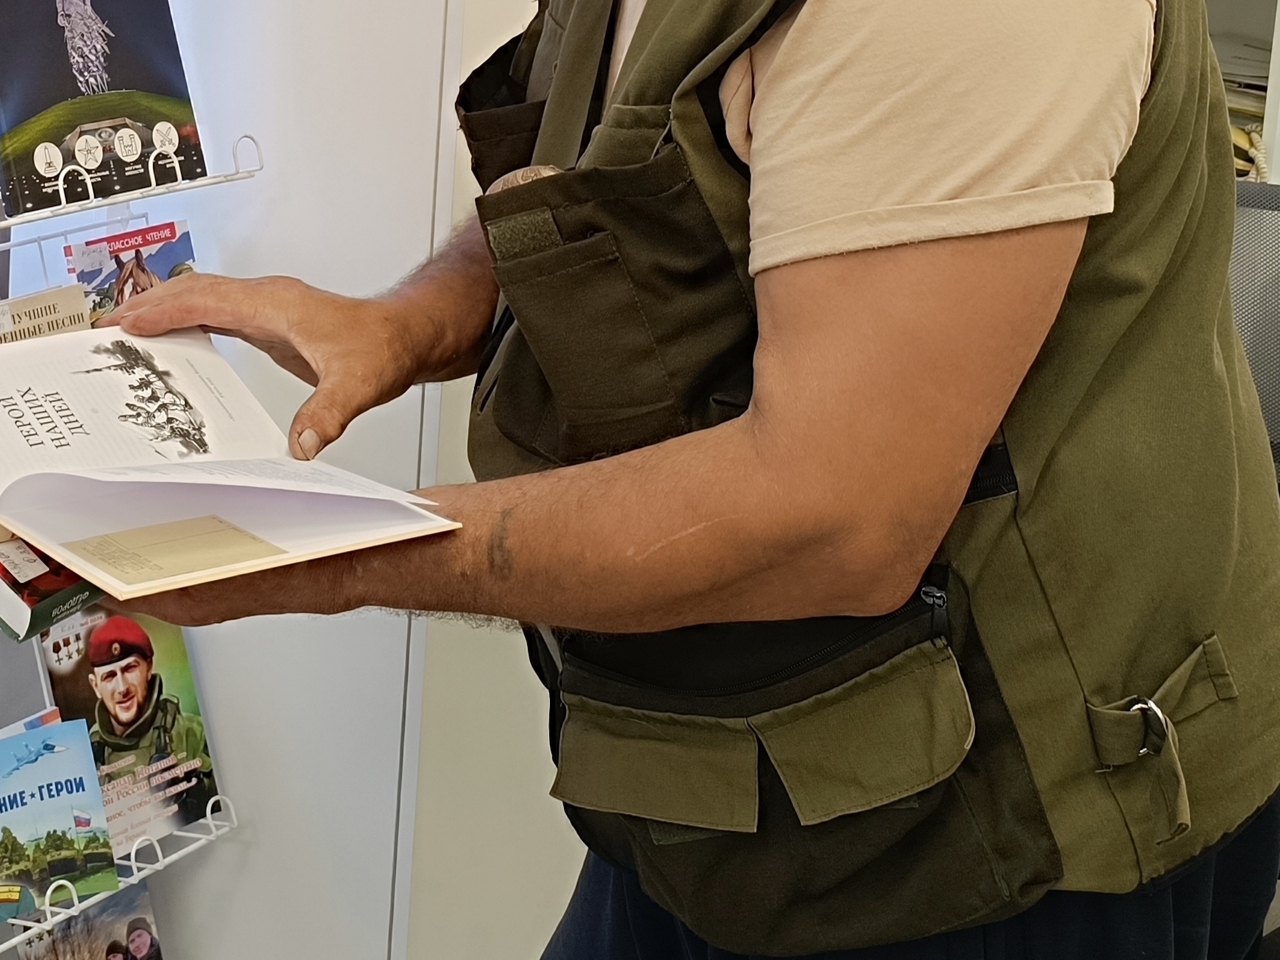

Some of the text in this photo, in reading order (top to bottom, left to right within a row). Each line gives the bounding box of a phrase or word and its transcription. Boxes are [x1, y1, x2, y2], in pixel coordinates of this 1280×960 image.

[107, 228, 172, 252] КЛАССНОЕ ЧТЕНИЕ
[50, 312, 85, 335] ПЕСНИ
[0, 396, 44, 448] ГЕРОИ
[16, 387, 71, 450] НАШИХ
[44, 391, 90, 437] ДНЕЙ
[38, 777, 86, 802] ГЕРОИ
[115, 781, 150, 800] России
